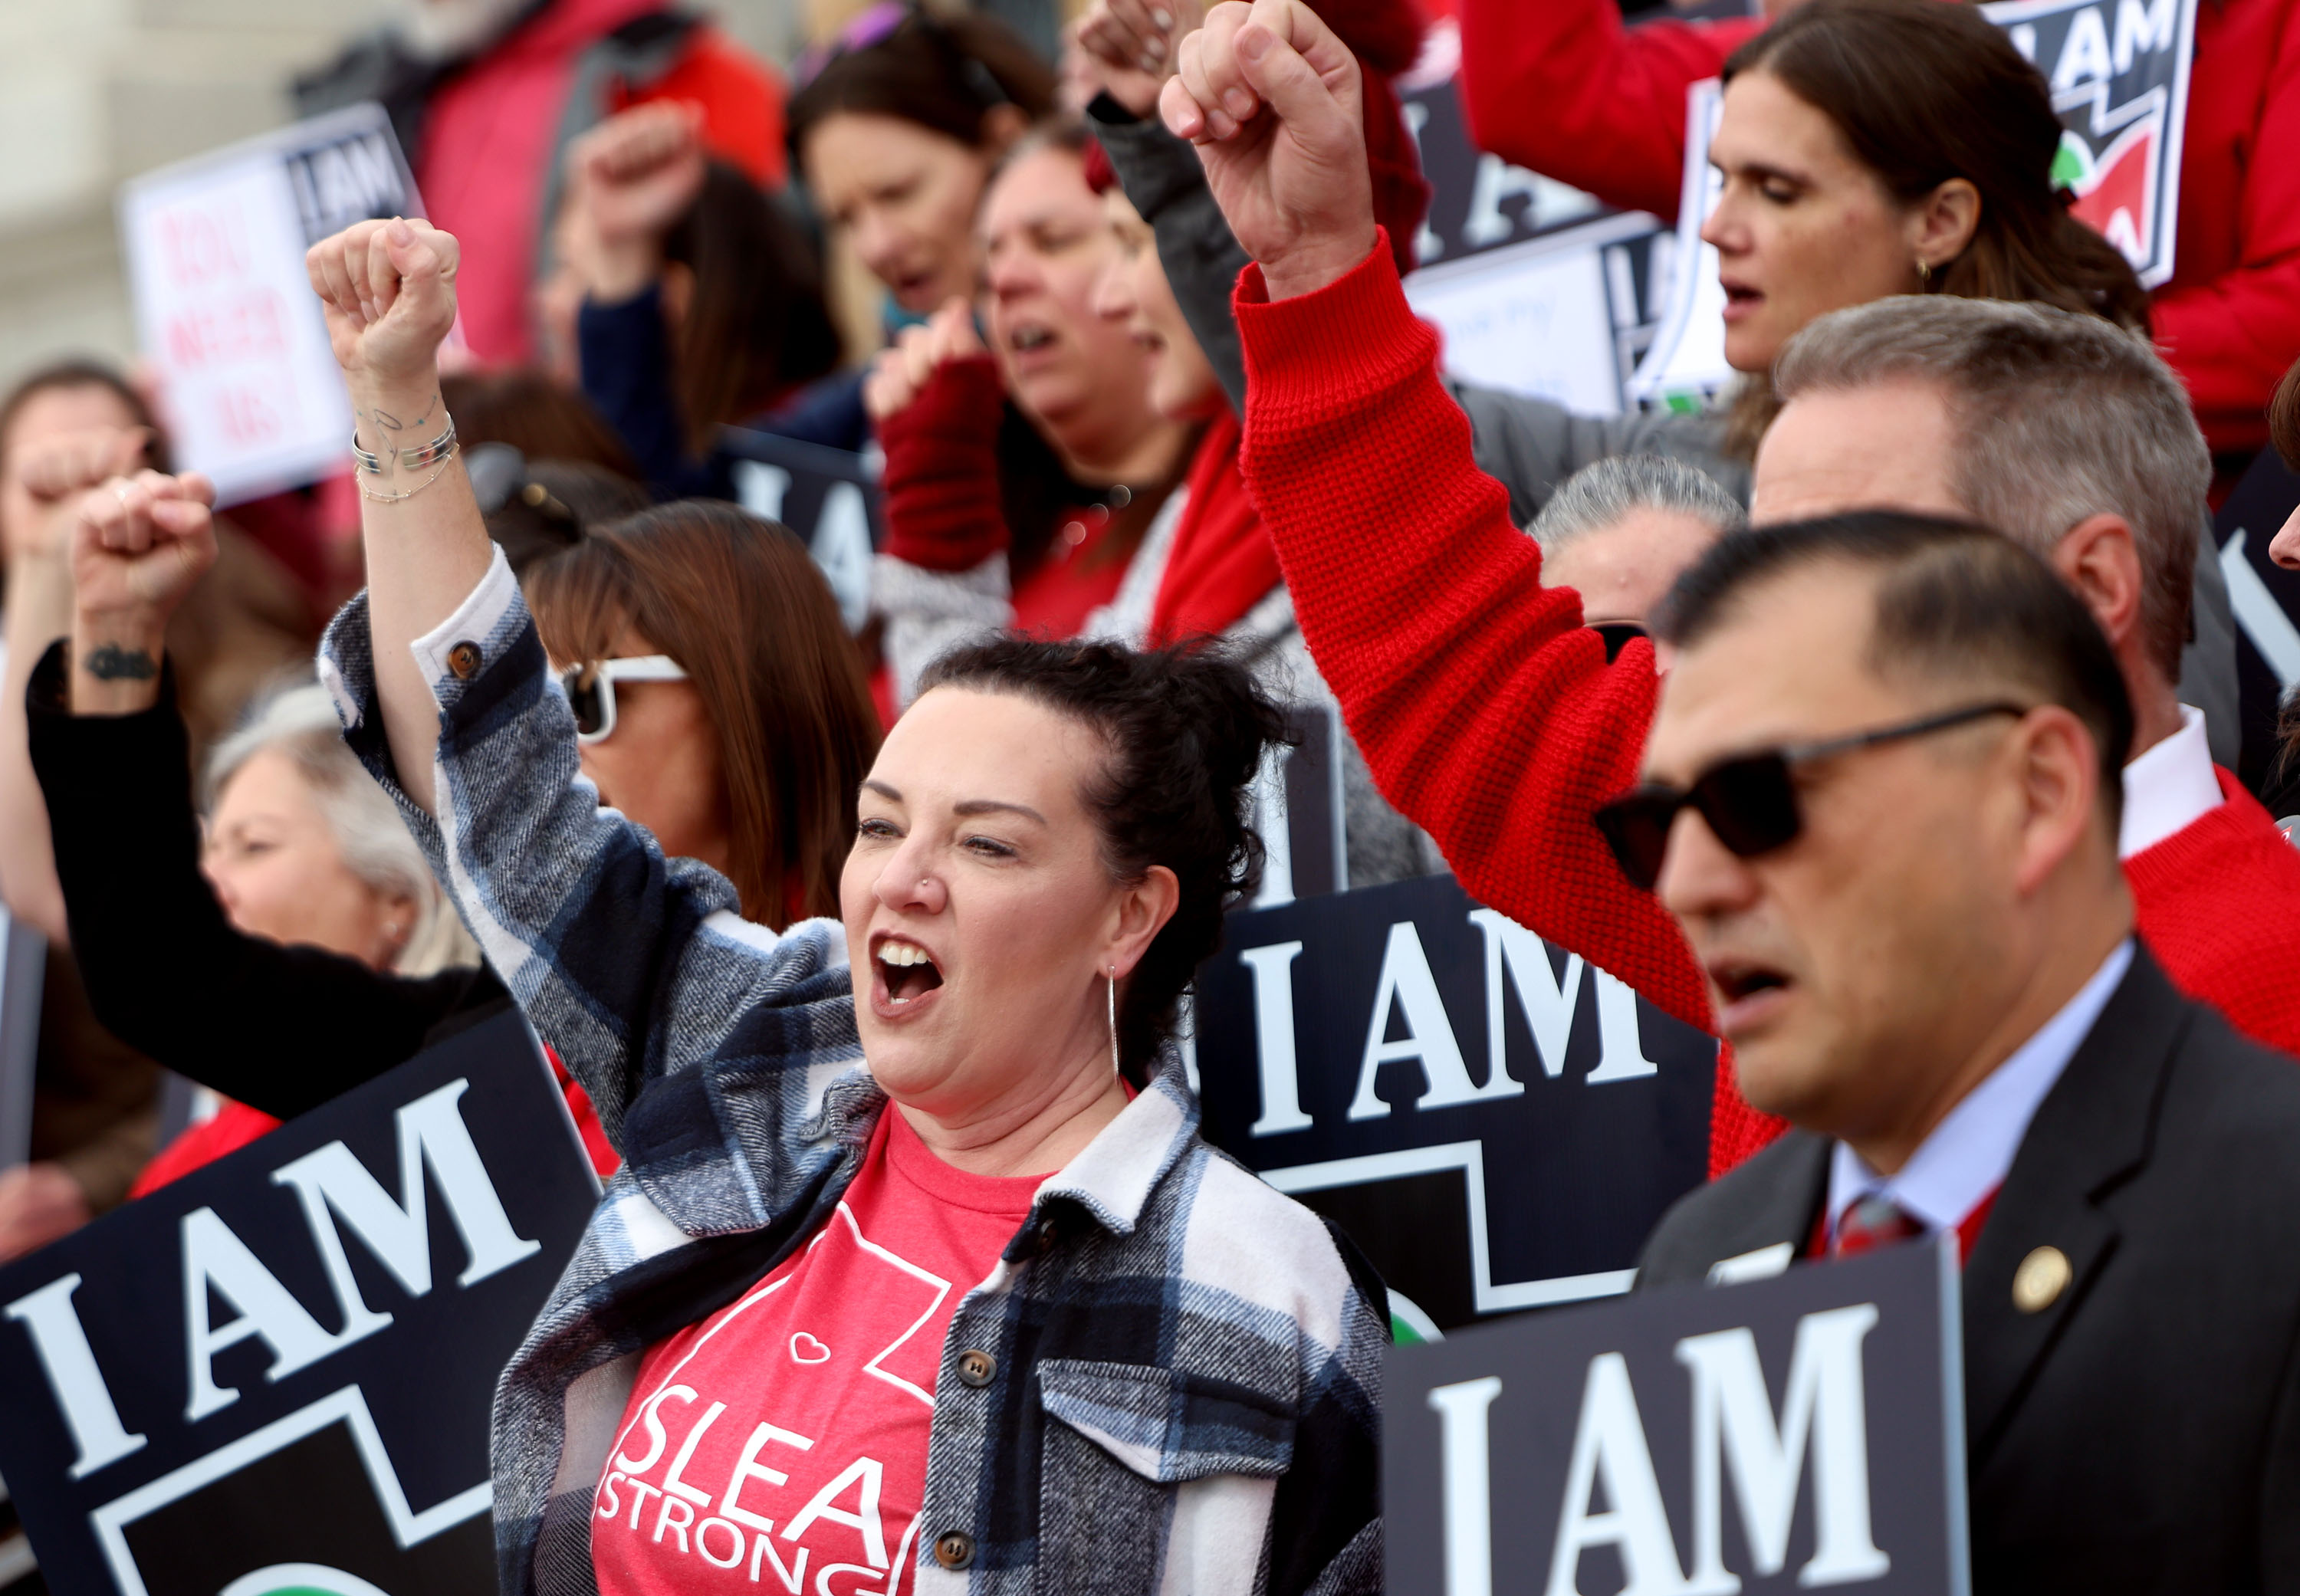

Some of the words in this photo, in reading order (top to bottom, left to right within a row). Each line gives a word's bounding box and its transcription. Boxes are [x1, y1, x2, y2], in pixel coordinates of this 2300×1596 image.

[2049, 0, 2183, 91] AM
[1239, 940, 1313, 1138] I
[1349, 908, 1658, 1124] AM
[4, 1273, 149, 1480] I
[181, 1077, 543, 1423] AM
[614, 1384, 890, 1571] SLEA
[1428, 1375, 1503, 1596] I
[1543, 1302, 1892, 1596] AM
